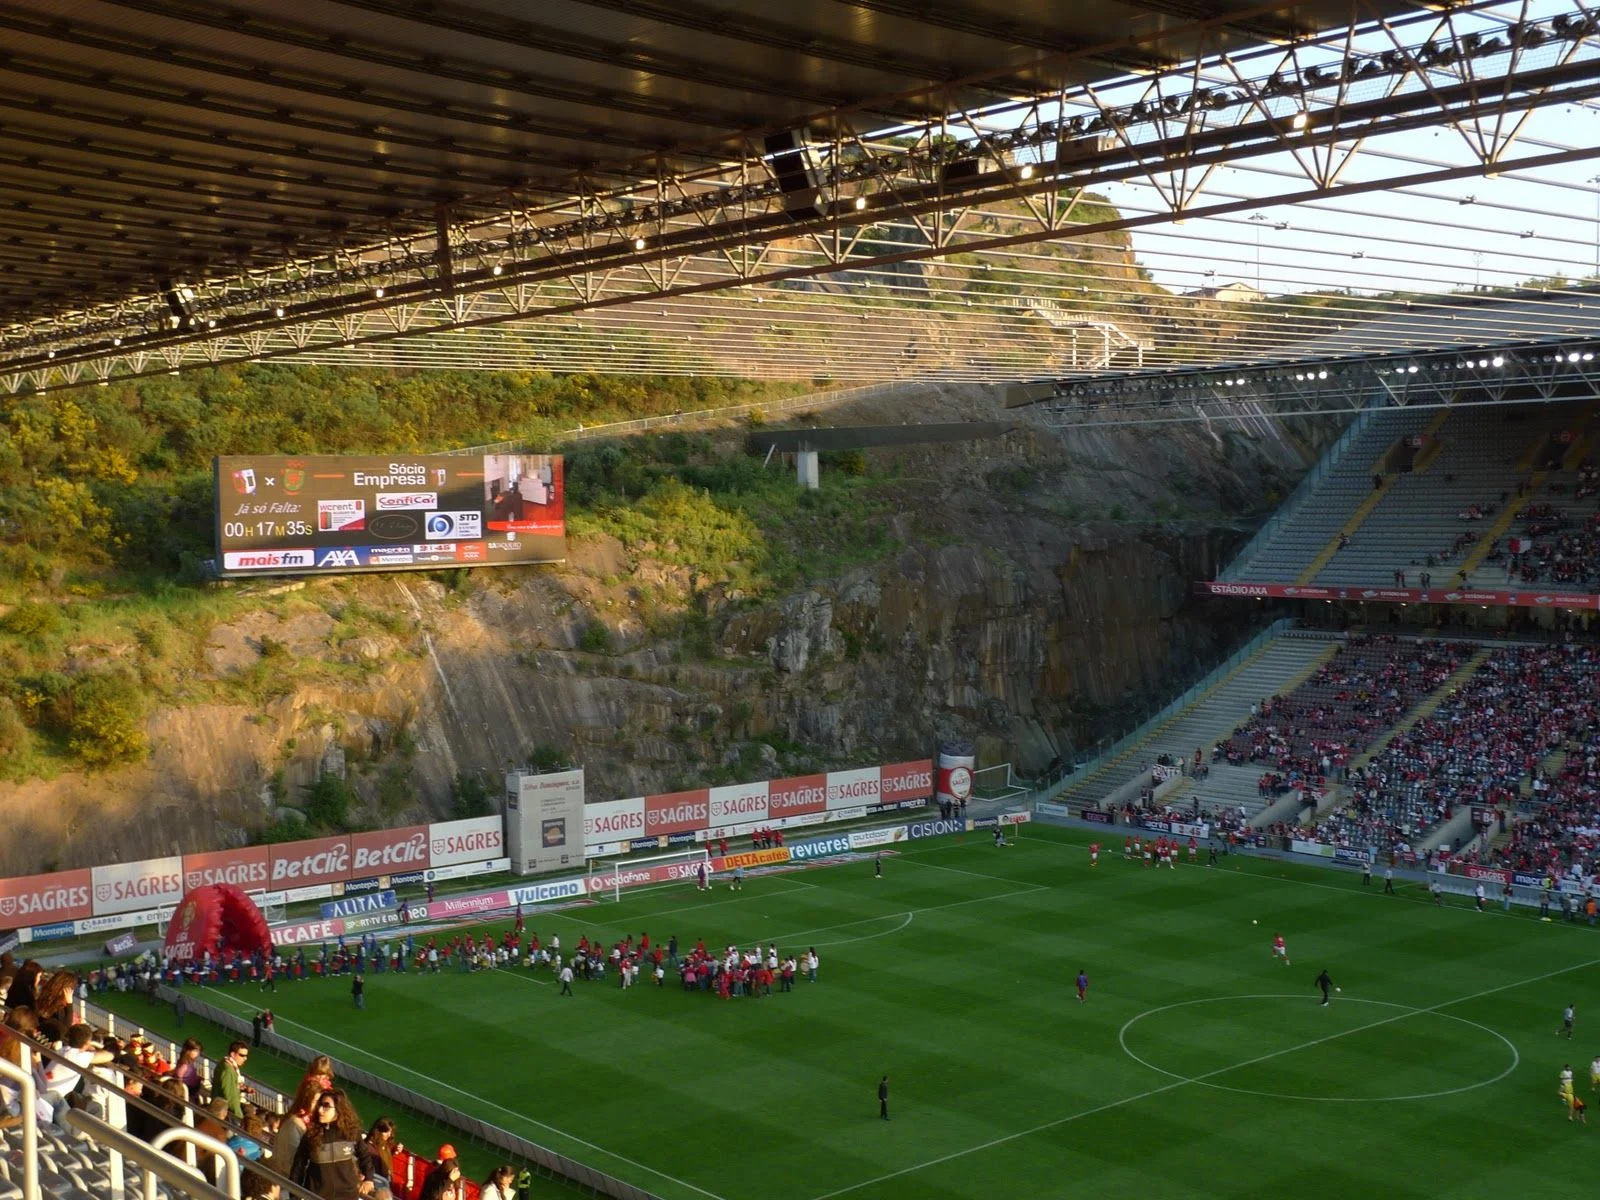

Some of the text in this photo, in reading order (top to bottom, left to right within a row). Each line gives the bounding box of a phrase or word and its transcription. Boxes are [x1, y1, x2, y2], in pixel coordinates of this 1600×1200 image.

[389, 463, 426, 476] Sócio
[354, 472, 427, 489] Empresa
[235, 502, 302, 516] Já só Falta:
[459, 513, 479, 521] STD
[317, 550, 361, 567] AXA
[1211, 584, 1267, 595] ESTÁDIO AXA
[839, 780, 879, 799] SAGRES
[893, 772, 932, 792] SAGRES
[723, 795, 767, 815] SAGRES
[783, 787, 825, 808] SAGRES
[595, 811, 643, 833] SAGRES
[660, 803, 707, 825] SAGRES
[911, 820, 955, 838] CISION
[448, 830, 500, 854] SAGRES
[354, 834, 428, 869] BetClic
[272, 844, 350, 882] BetClic
[726, 853, 758, 869] DELTA
[204, 862, 267, 886] SAGRES
[391, 874, 424, 886] Montepio
[605, 871, 650, 887] vodafone
[1478, 870, 1506, 883] SAGRES
[114, 873, 181, 901] SAGRES
[345, 882, 379, 893] Montepio
[515, 882, 578, 903] Vulcano
[18, 886, 89, 914] SAGRES
[444, 897, 493, 912] Millennium
[388, 914, 398, 922] no
[33, 925, 74, 938] Montepio
[165, 942, 196, 960] SAGRES
